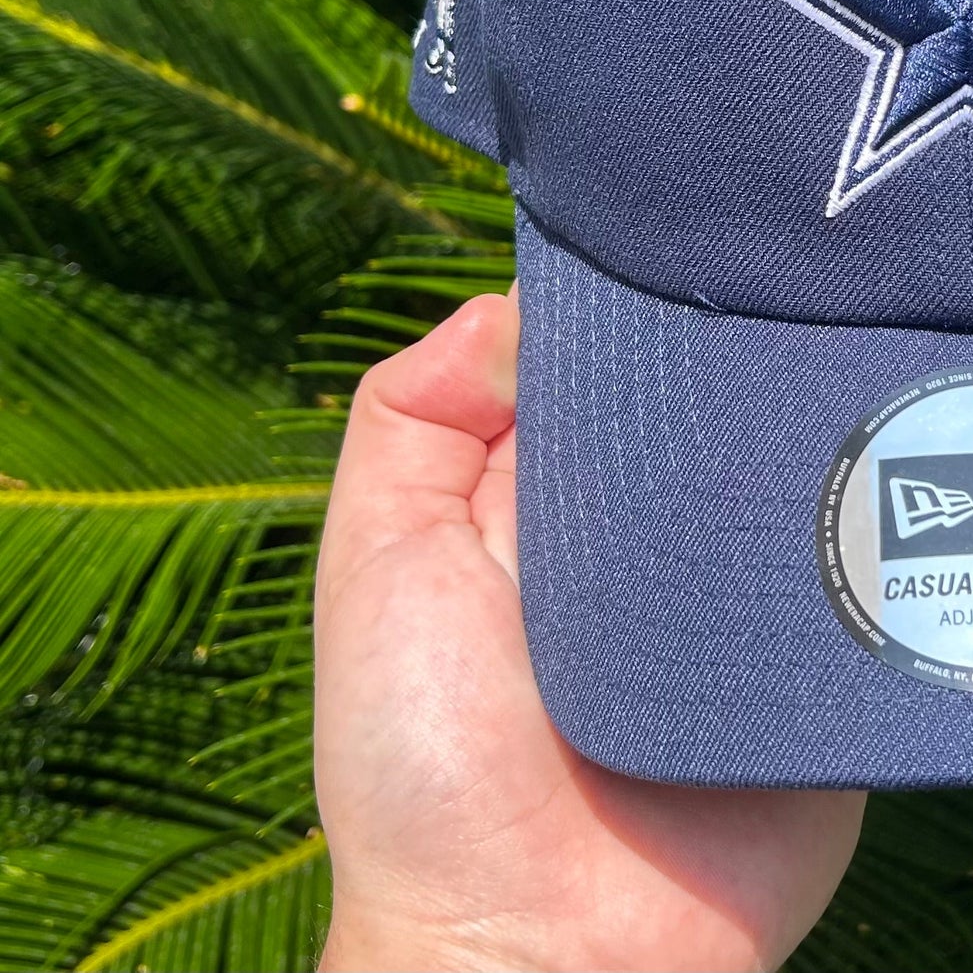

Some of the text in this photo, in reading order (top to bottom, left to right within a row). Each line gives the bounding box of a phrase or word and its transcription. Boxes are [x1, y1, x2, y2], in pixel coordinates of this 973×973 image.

[948, 373, 972, 382] SINCE
[864, 387, 921, 433] NEWERACAP.COM
[824, 510, 833, 527] USA
[825, 542, 834, 566] SINCE
[830, 567, 842, 588] 1920
[839, 591, 887, 647] NEWERACAP.COM
